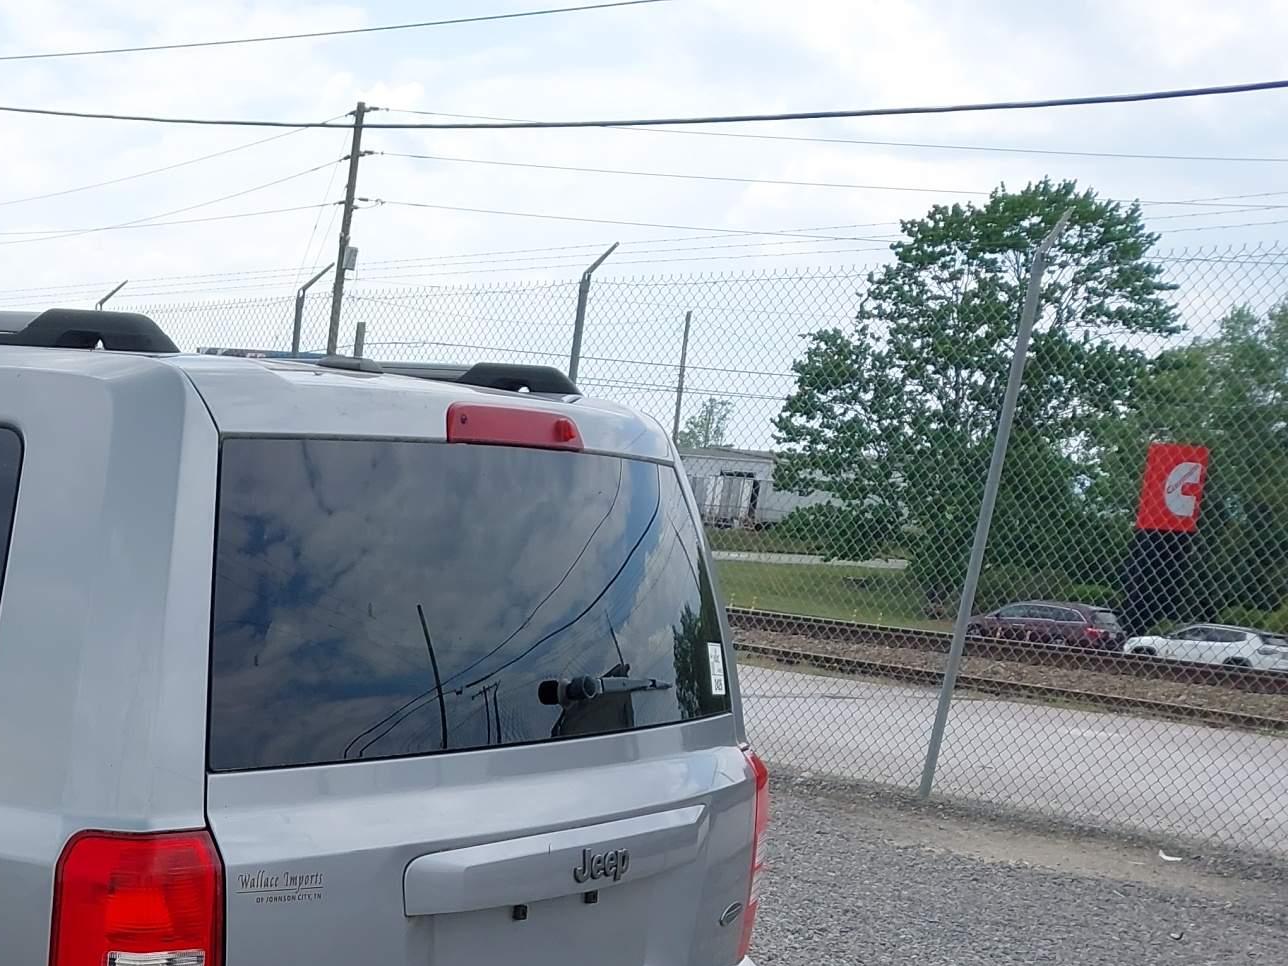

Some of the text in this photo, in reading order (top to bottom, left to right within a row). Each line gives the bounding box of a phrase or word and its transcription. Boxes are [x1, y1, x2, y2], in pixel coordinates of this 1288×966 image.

[574, 847, 630, 884] Jeep
[237, 870, 323, 893] Wallace Imports
[265, 894, 296, 904] JOHNSON
[313, 892, 322, 901] TN
